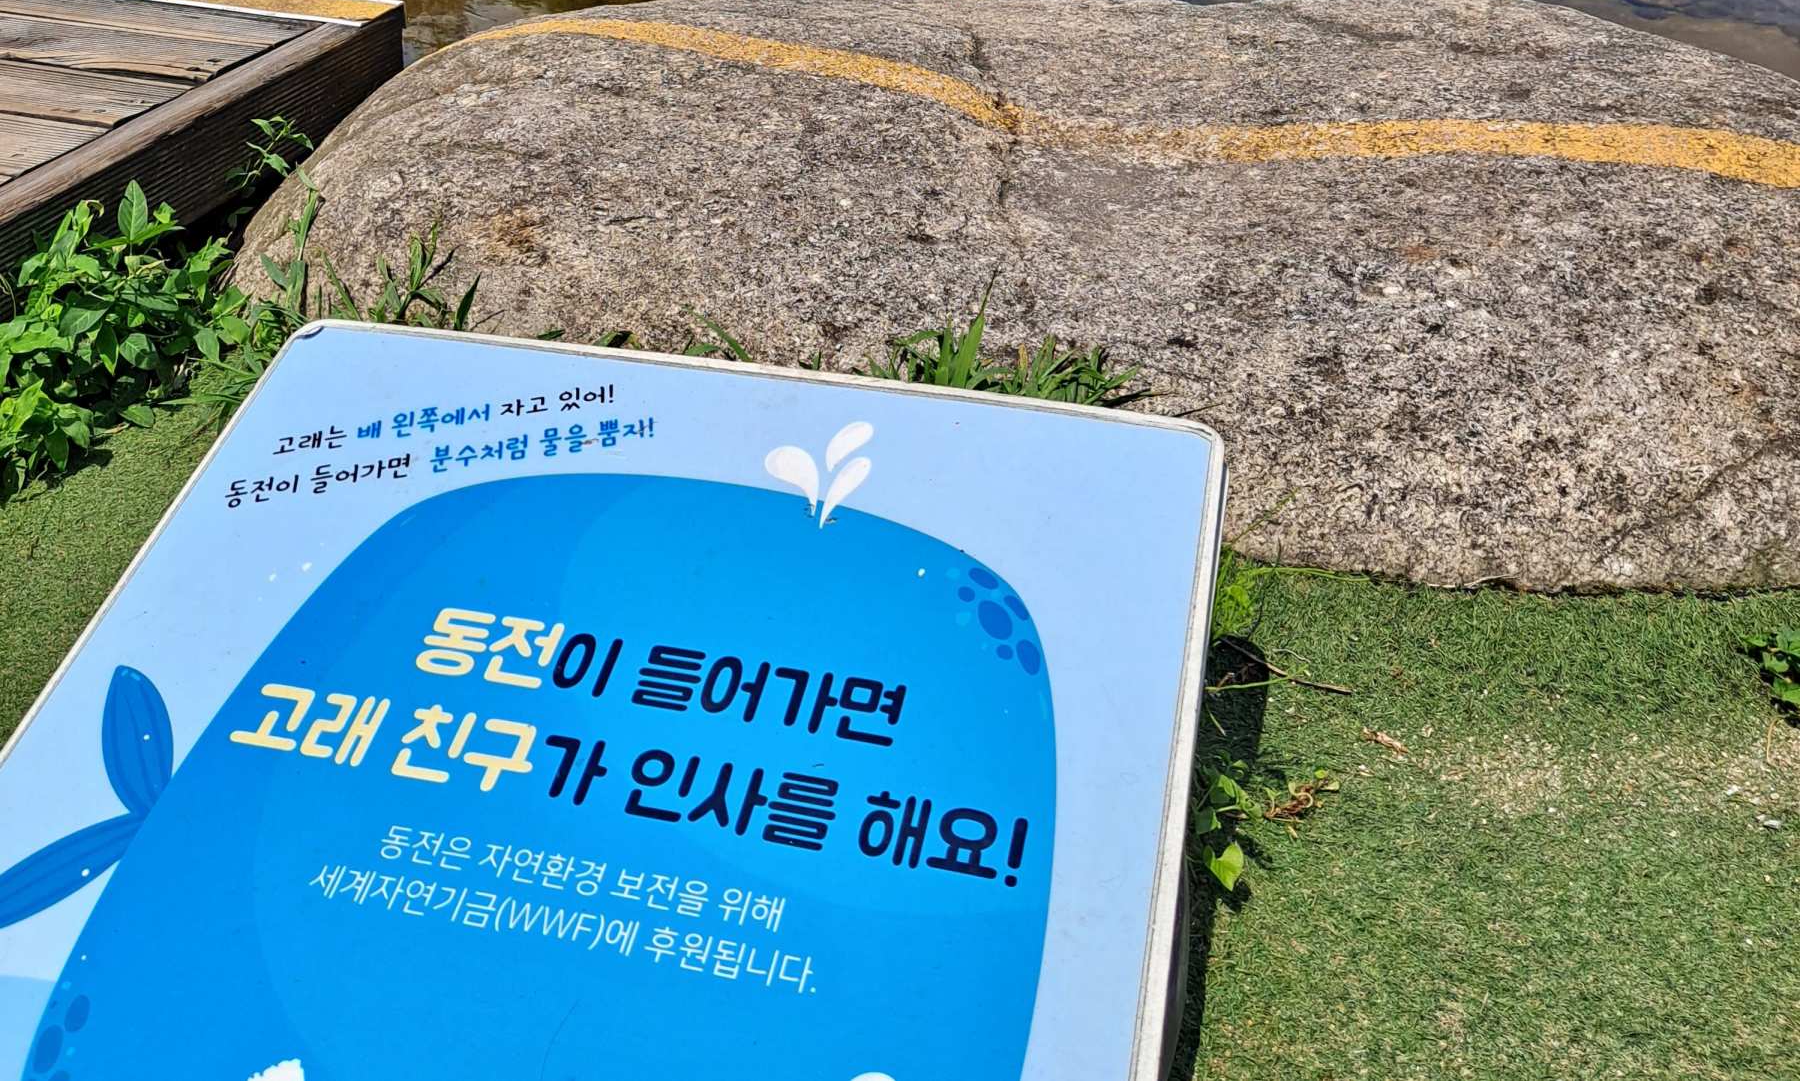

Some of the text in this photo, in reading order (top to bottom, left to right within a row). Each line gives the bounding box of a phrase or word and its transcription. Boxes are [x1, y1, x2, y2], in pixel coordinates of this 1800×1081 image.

[224, 417, 656, 510] 동전이 들어가면 분수처럼 물을 뿜자!
[271, 384, 616, 457] 고래는 배 왼쪽에서 자고 있어!
[414, 606, 909, 748] 동전이 들어가면
[228, 682, 1030, 889] 고래 친구가 인사를 해요!
[309, 861, 818, 996] 세계자연기금(WWF)에 후원됩니다.
[378, 824, 786, 933] 동전은 자연환경 보전을 위해
